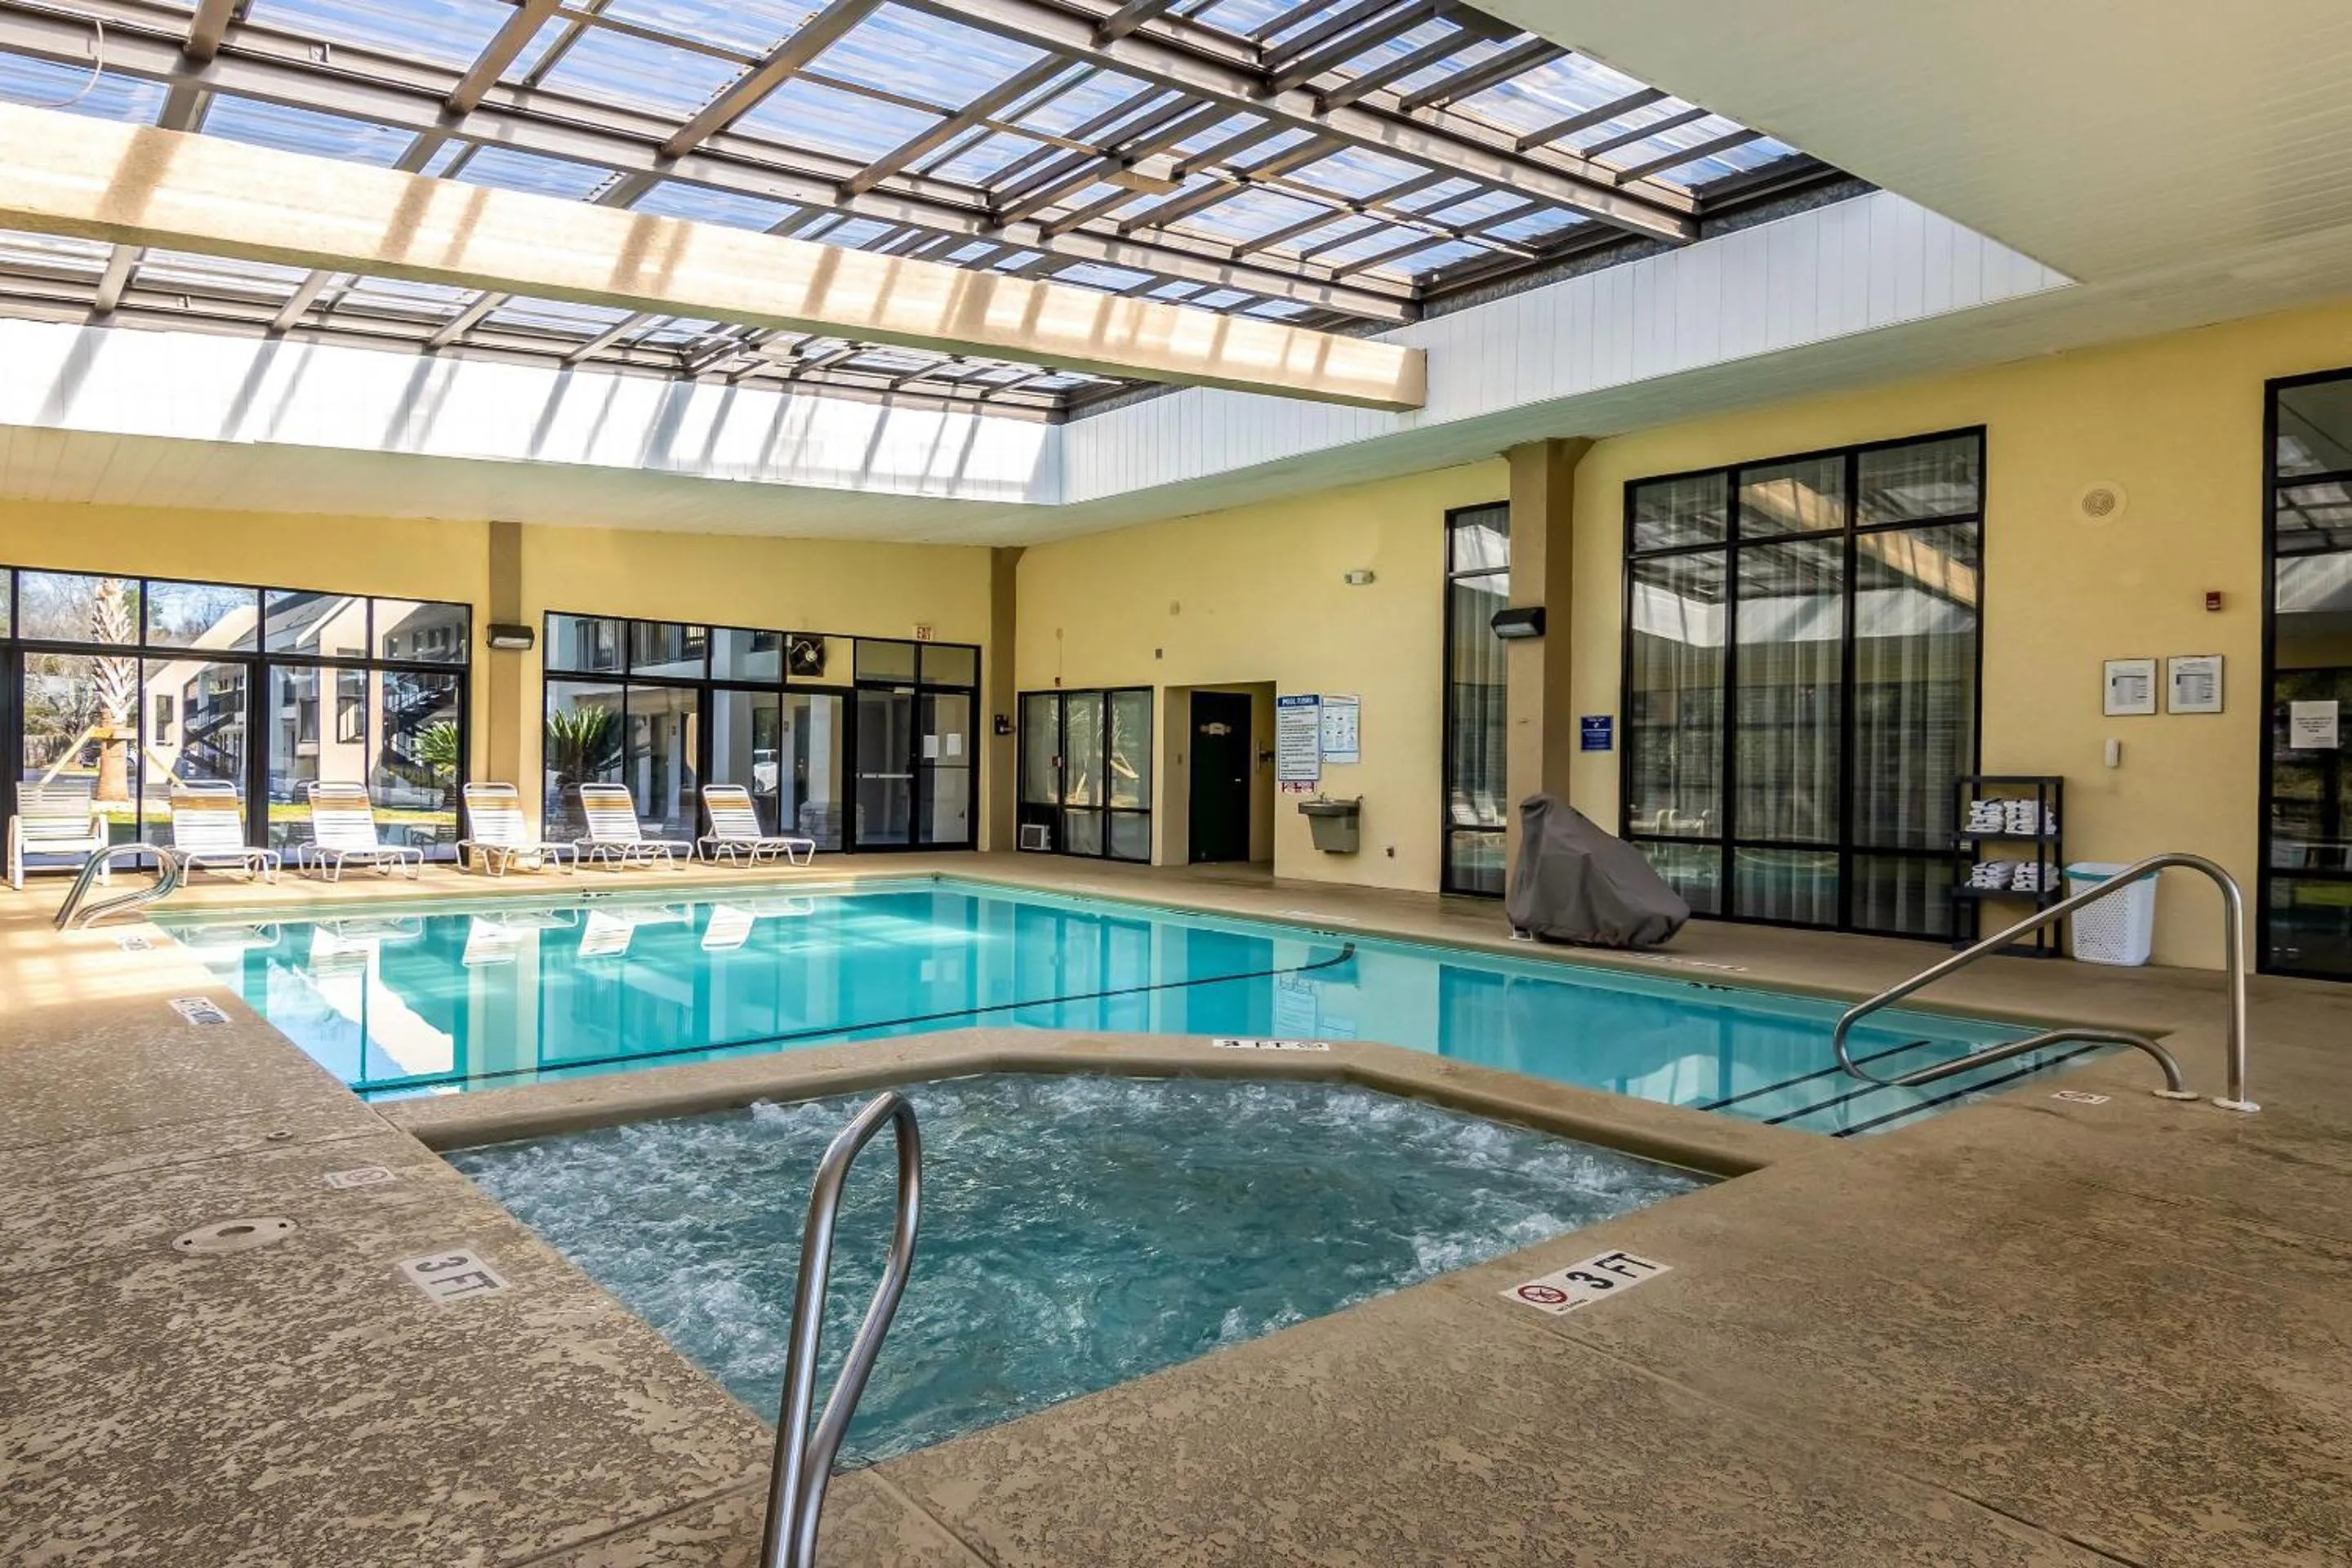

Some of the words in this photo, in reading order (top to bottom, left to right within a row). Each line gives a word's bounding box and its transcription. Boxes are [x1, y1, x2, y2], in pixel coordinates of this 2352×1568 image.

[415, 1256, 469, 1272] 3
[1566, 1271, 1615, 1290] 3
[1592, 1252, 1657, 1279] FT
[430, 1270, 500, 1297] FT
